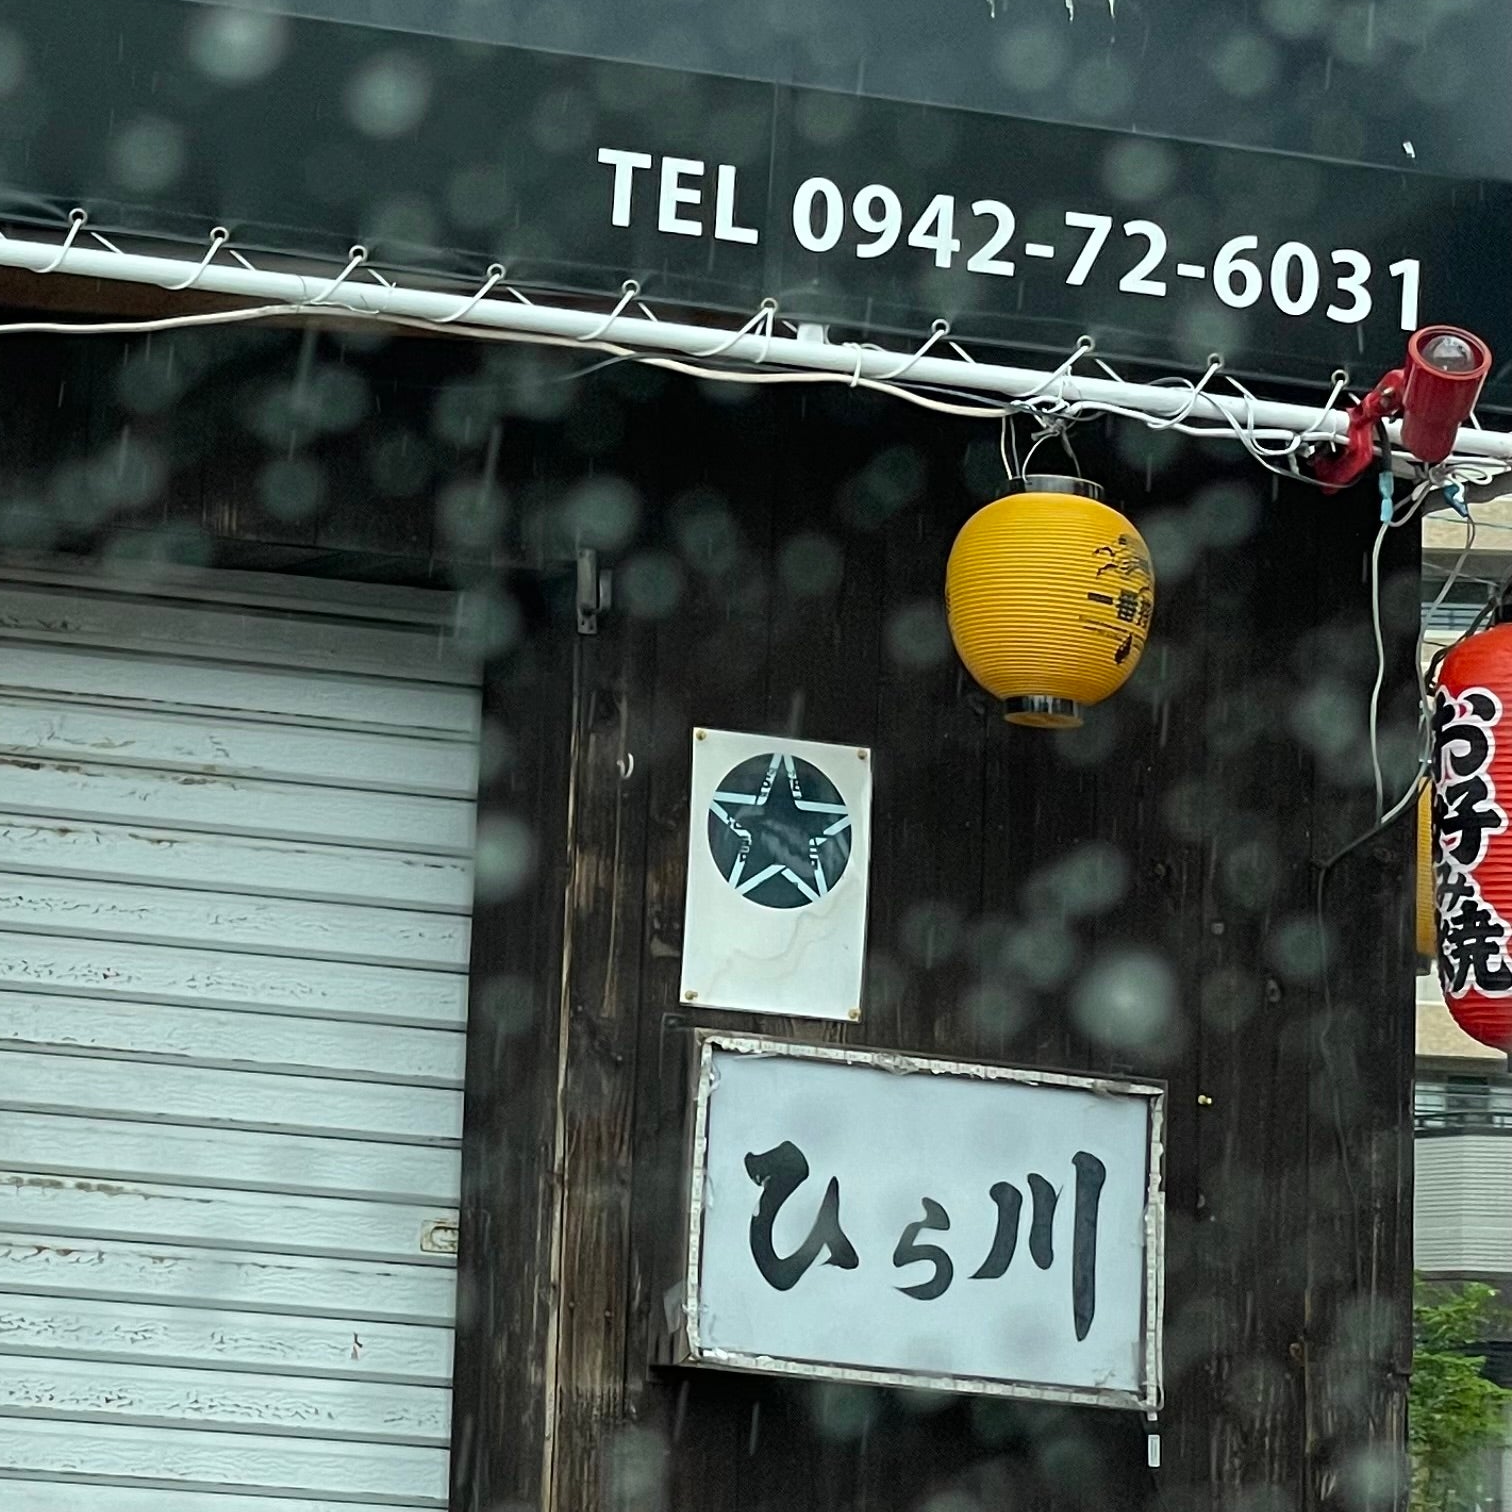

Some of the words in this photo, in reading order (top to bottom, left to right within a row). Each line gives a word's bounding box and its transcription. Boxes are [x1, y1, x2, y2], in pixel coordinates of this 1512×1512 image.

[597, 148, 759, 245] TEL
[792, 176, 1420, 331] 0942-72-6031
[744, 1140, 1107, 1342] ひら川
